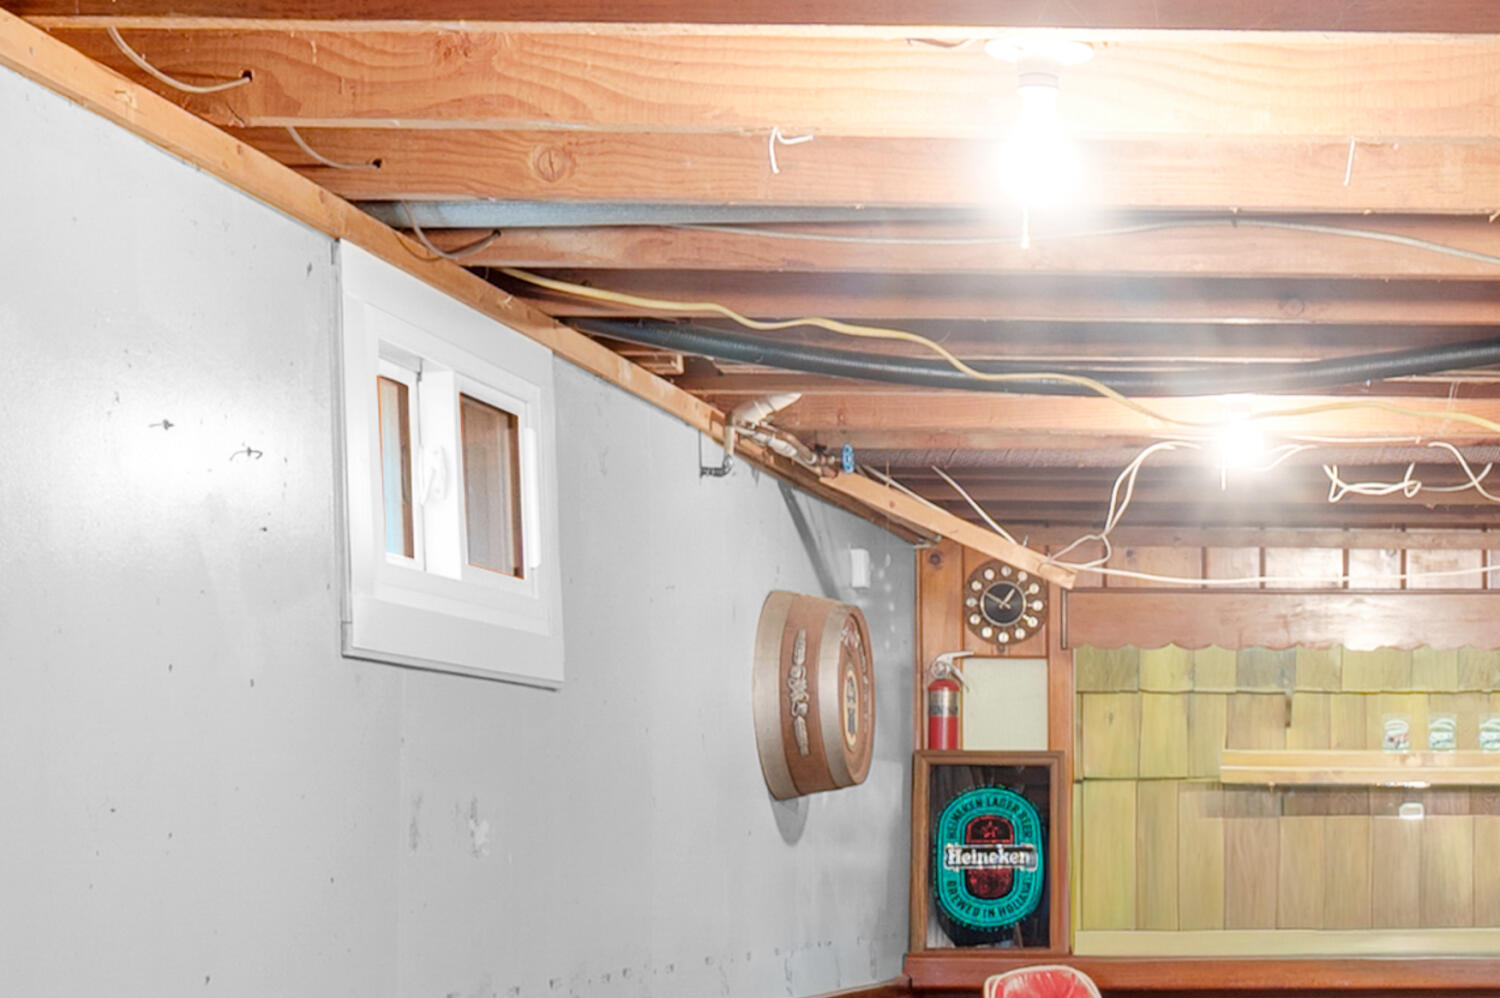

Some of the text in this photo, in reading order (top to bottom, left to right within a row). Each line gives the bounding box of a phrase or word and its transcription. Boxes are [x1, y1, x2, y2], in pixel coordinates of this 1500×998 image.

[948, 847, 1030, 865] Heineken
[946, 880, 981, 917] BREWED
[983, 909, 995, 918] IN
